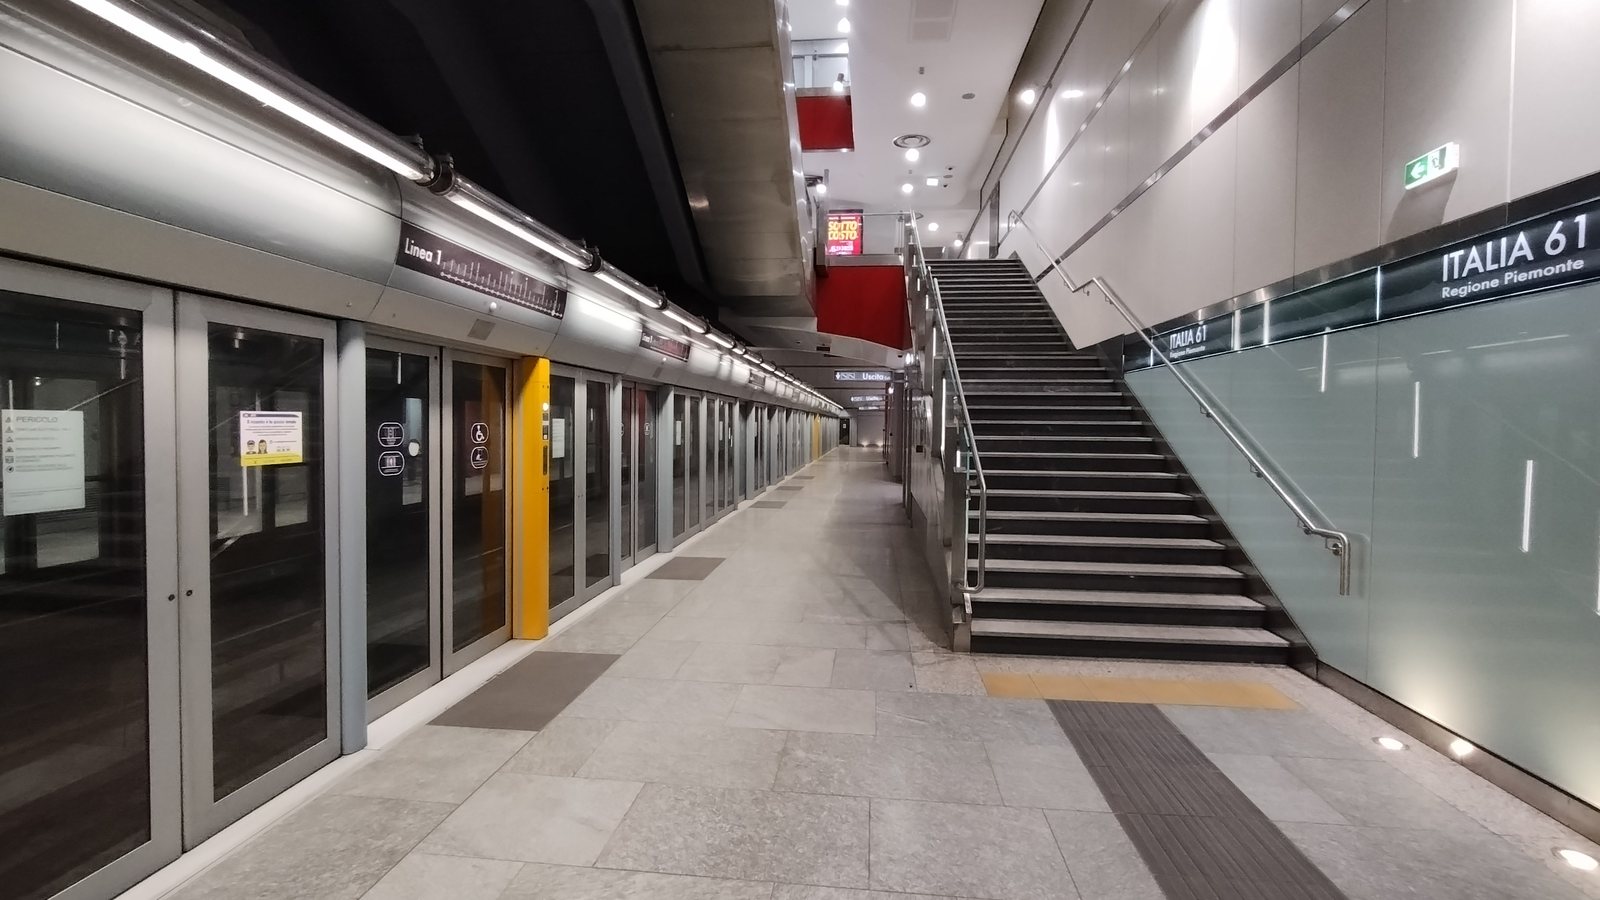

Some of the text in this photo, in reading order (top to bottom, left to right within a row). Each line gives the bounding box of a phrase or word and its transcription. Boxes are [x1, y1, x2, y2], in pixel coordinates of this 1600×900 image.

[828, 220, 858, 231] SOTTO
[828, 230, 858, 241] COSTO
[404, 237, 442, 266] Linea 1
[1442, 213, 1587, 282] ITALIA 61
[1441, 258, 1585, 299] Regione Piemonte
[1169, 324, 1207, 350] ITALIA 61
[862, 372, 884, 381] Uscita
